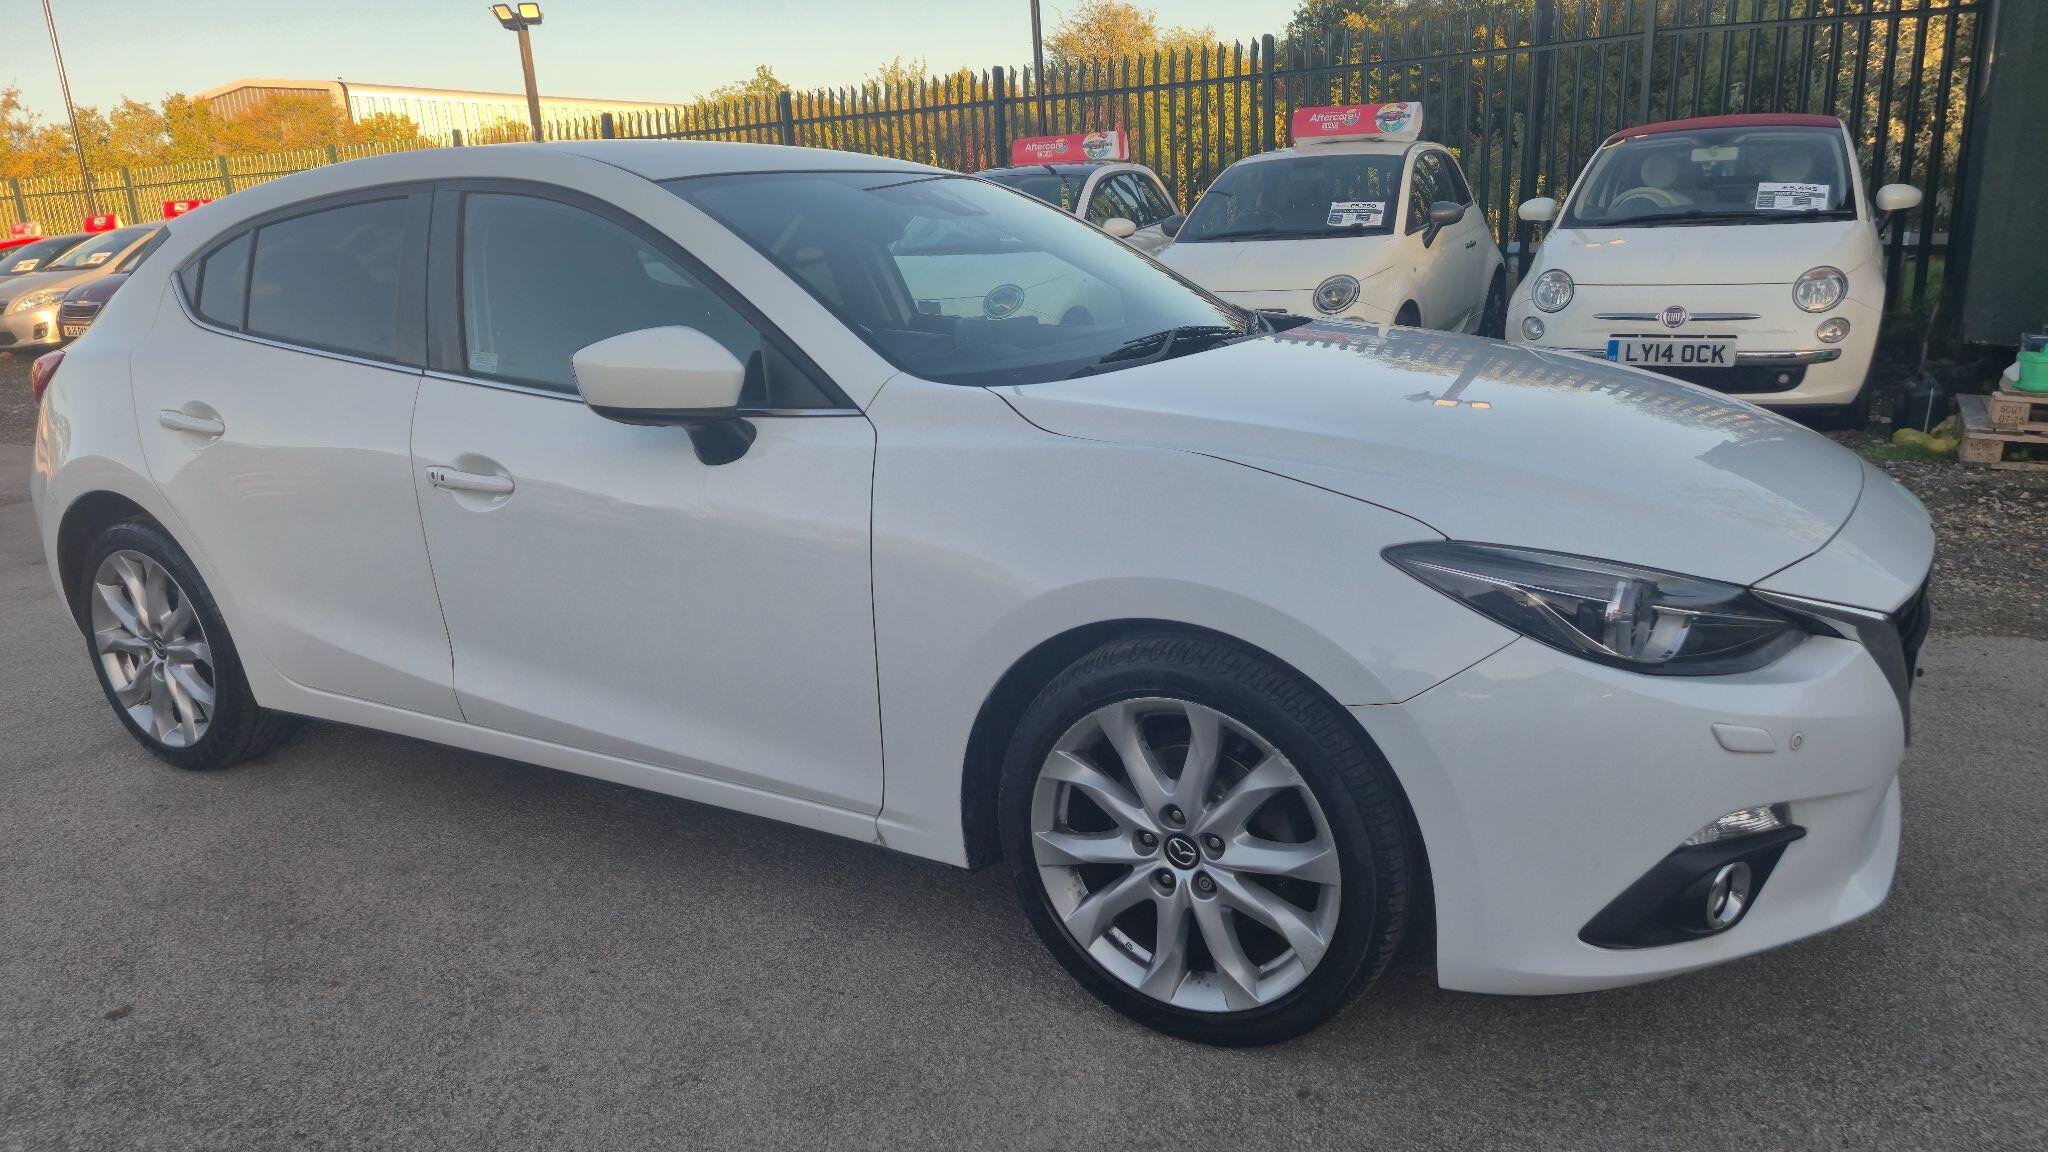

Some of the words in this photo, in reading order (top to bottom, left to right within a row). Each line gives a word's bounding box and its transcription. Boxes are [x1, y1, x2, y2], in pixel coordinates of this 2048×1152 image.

[1309, 113, 1354, 122] Aftercare
[1024, 142, 1064, 151] Aftercare
[1667, 312, 1681, 322] FIAT
[1625, 343, 1674, 362] LY14
[1680, 344, 1726, 363] OCK
